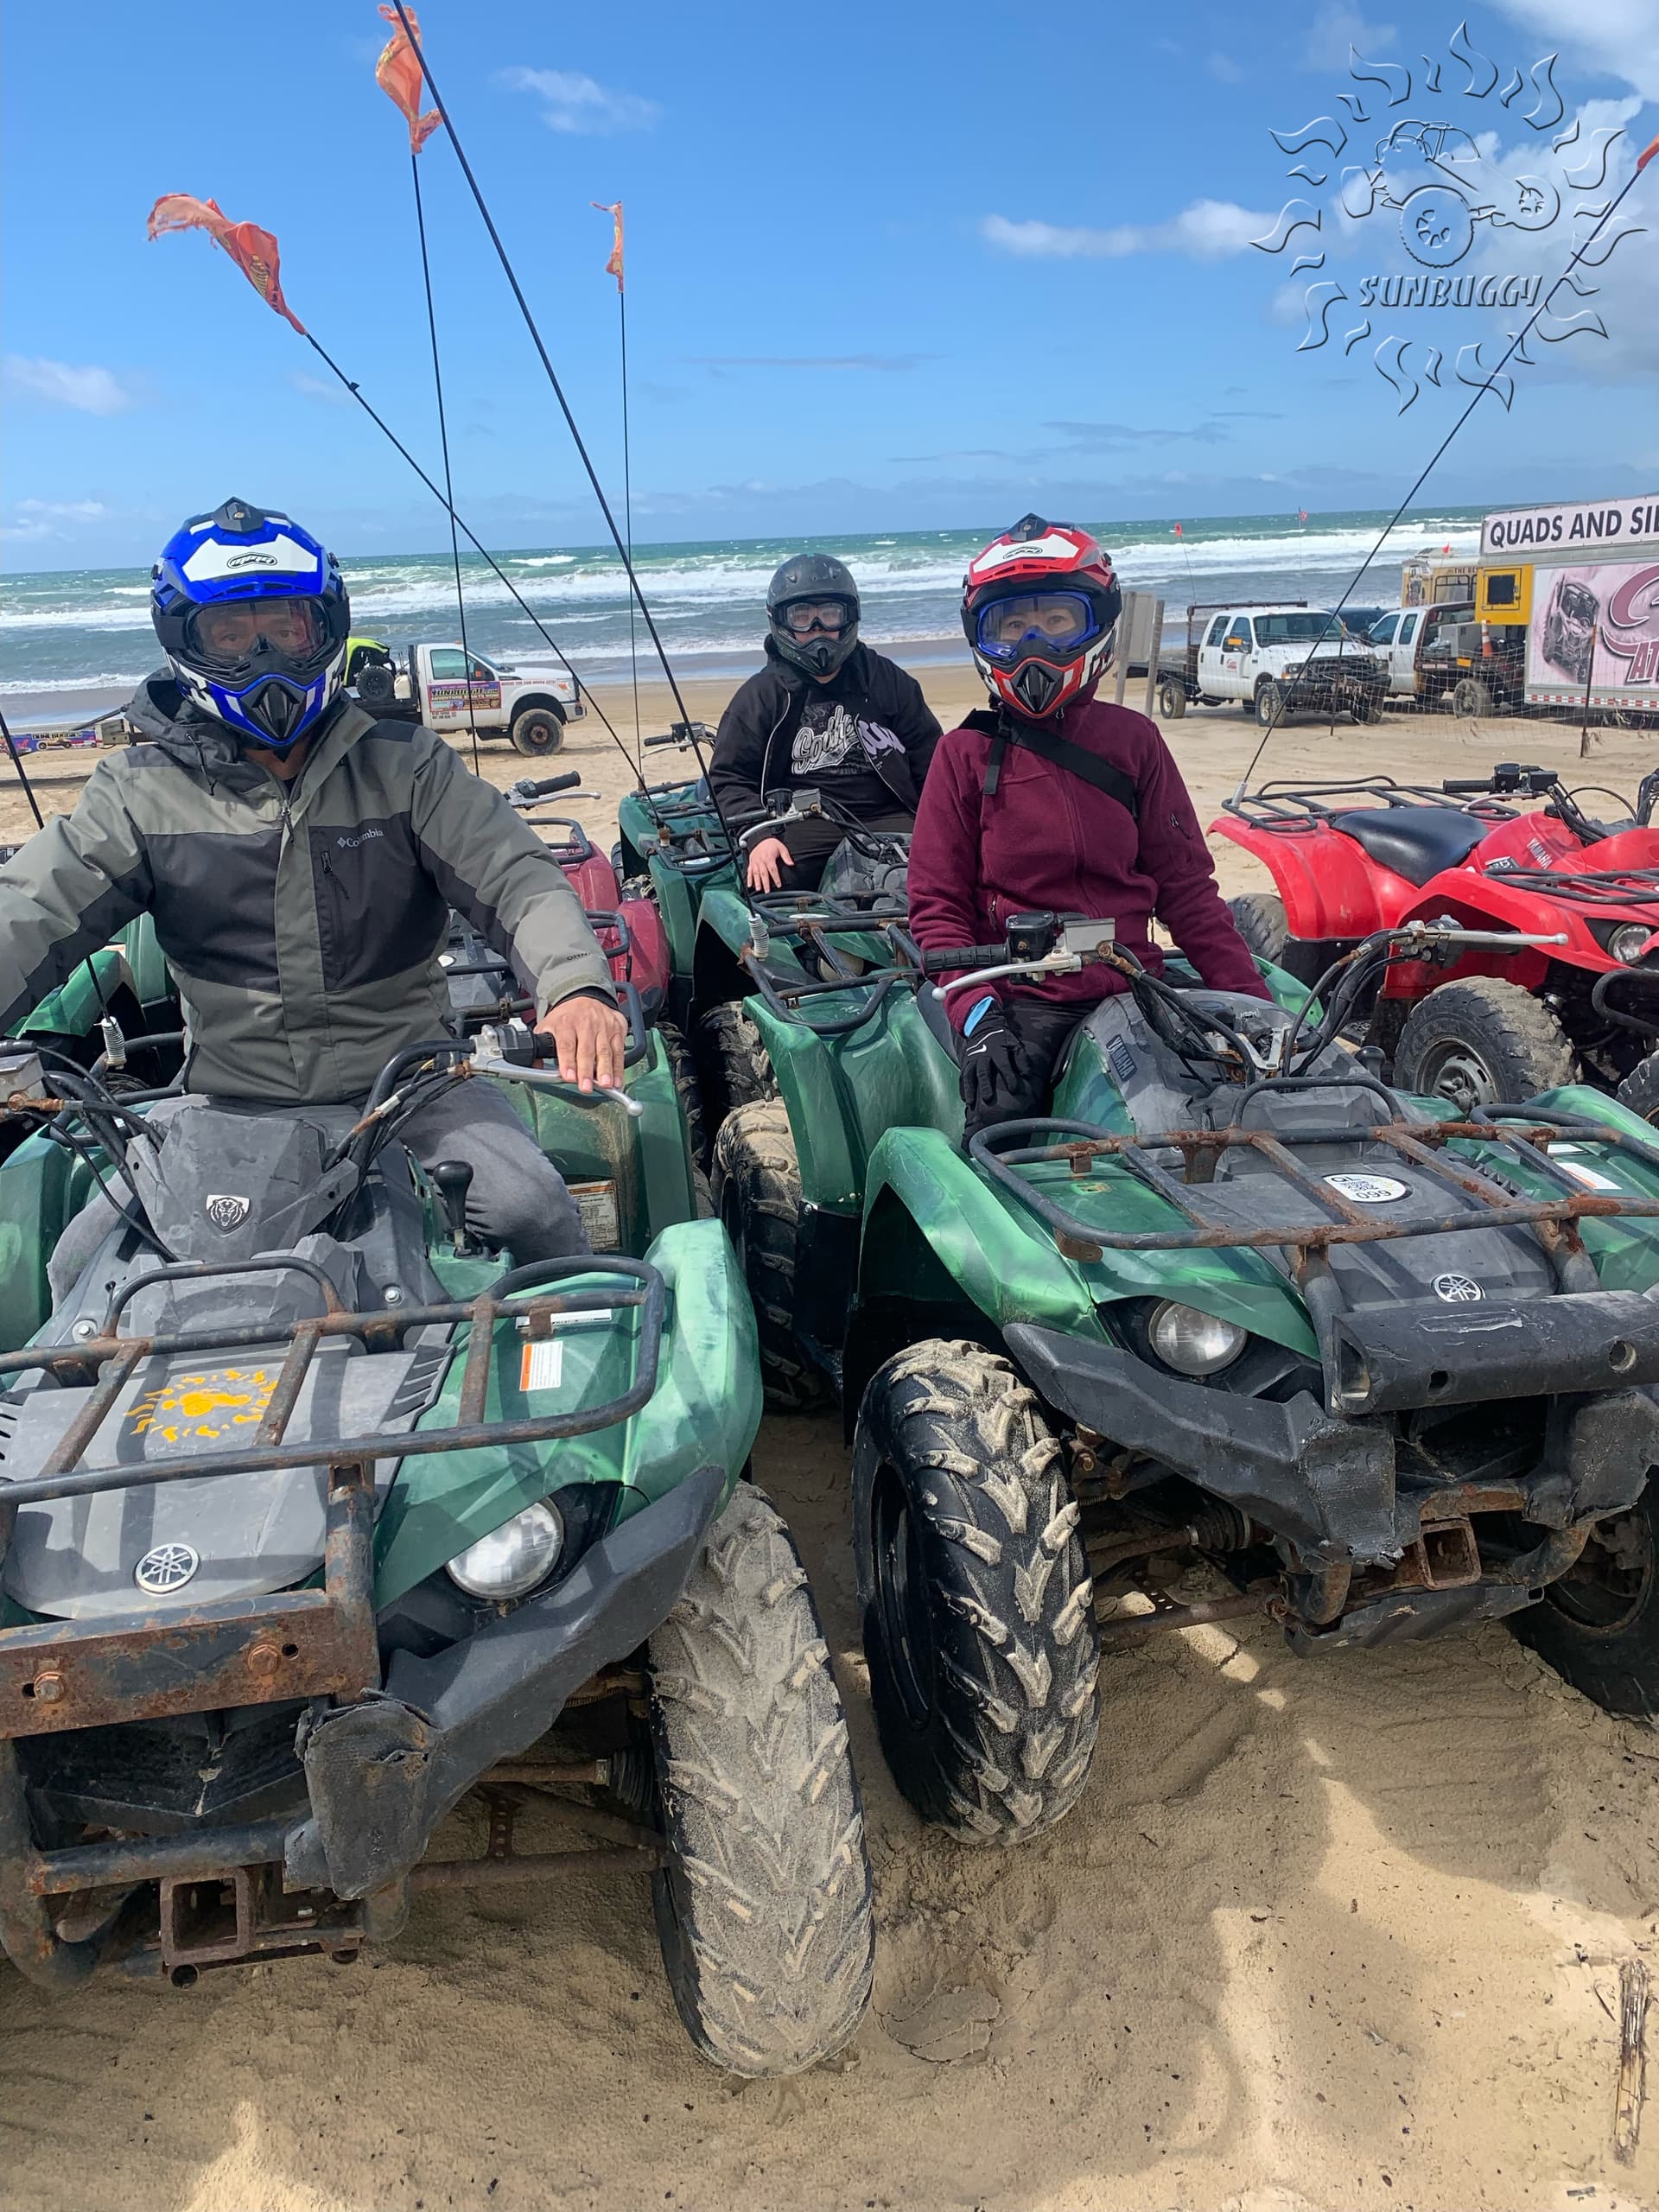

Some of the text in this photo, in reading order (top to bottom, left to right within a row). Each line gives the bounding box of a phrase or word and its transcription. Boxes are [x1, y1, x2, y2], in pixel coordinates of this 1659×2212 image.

[1490, 515, 1563, 548] QUADS
[1569, 510, 1622, 540] AND
[1627, 640, 1659, 682] AT
[346, 828, 384, 848] Combia
[1527, 837, 1553, 869] YAMAHA
[1107, 1036, 1135, 1078] YAMAHA
[1356, 1190, 1392, 1199] 099
